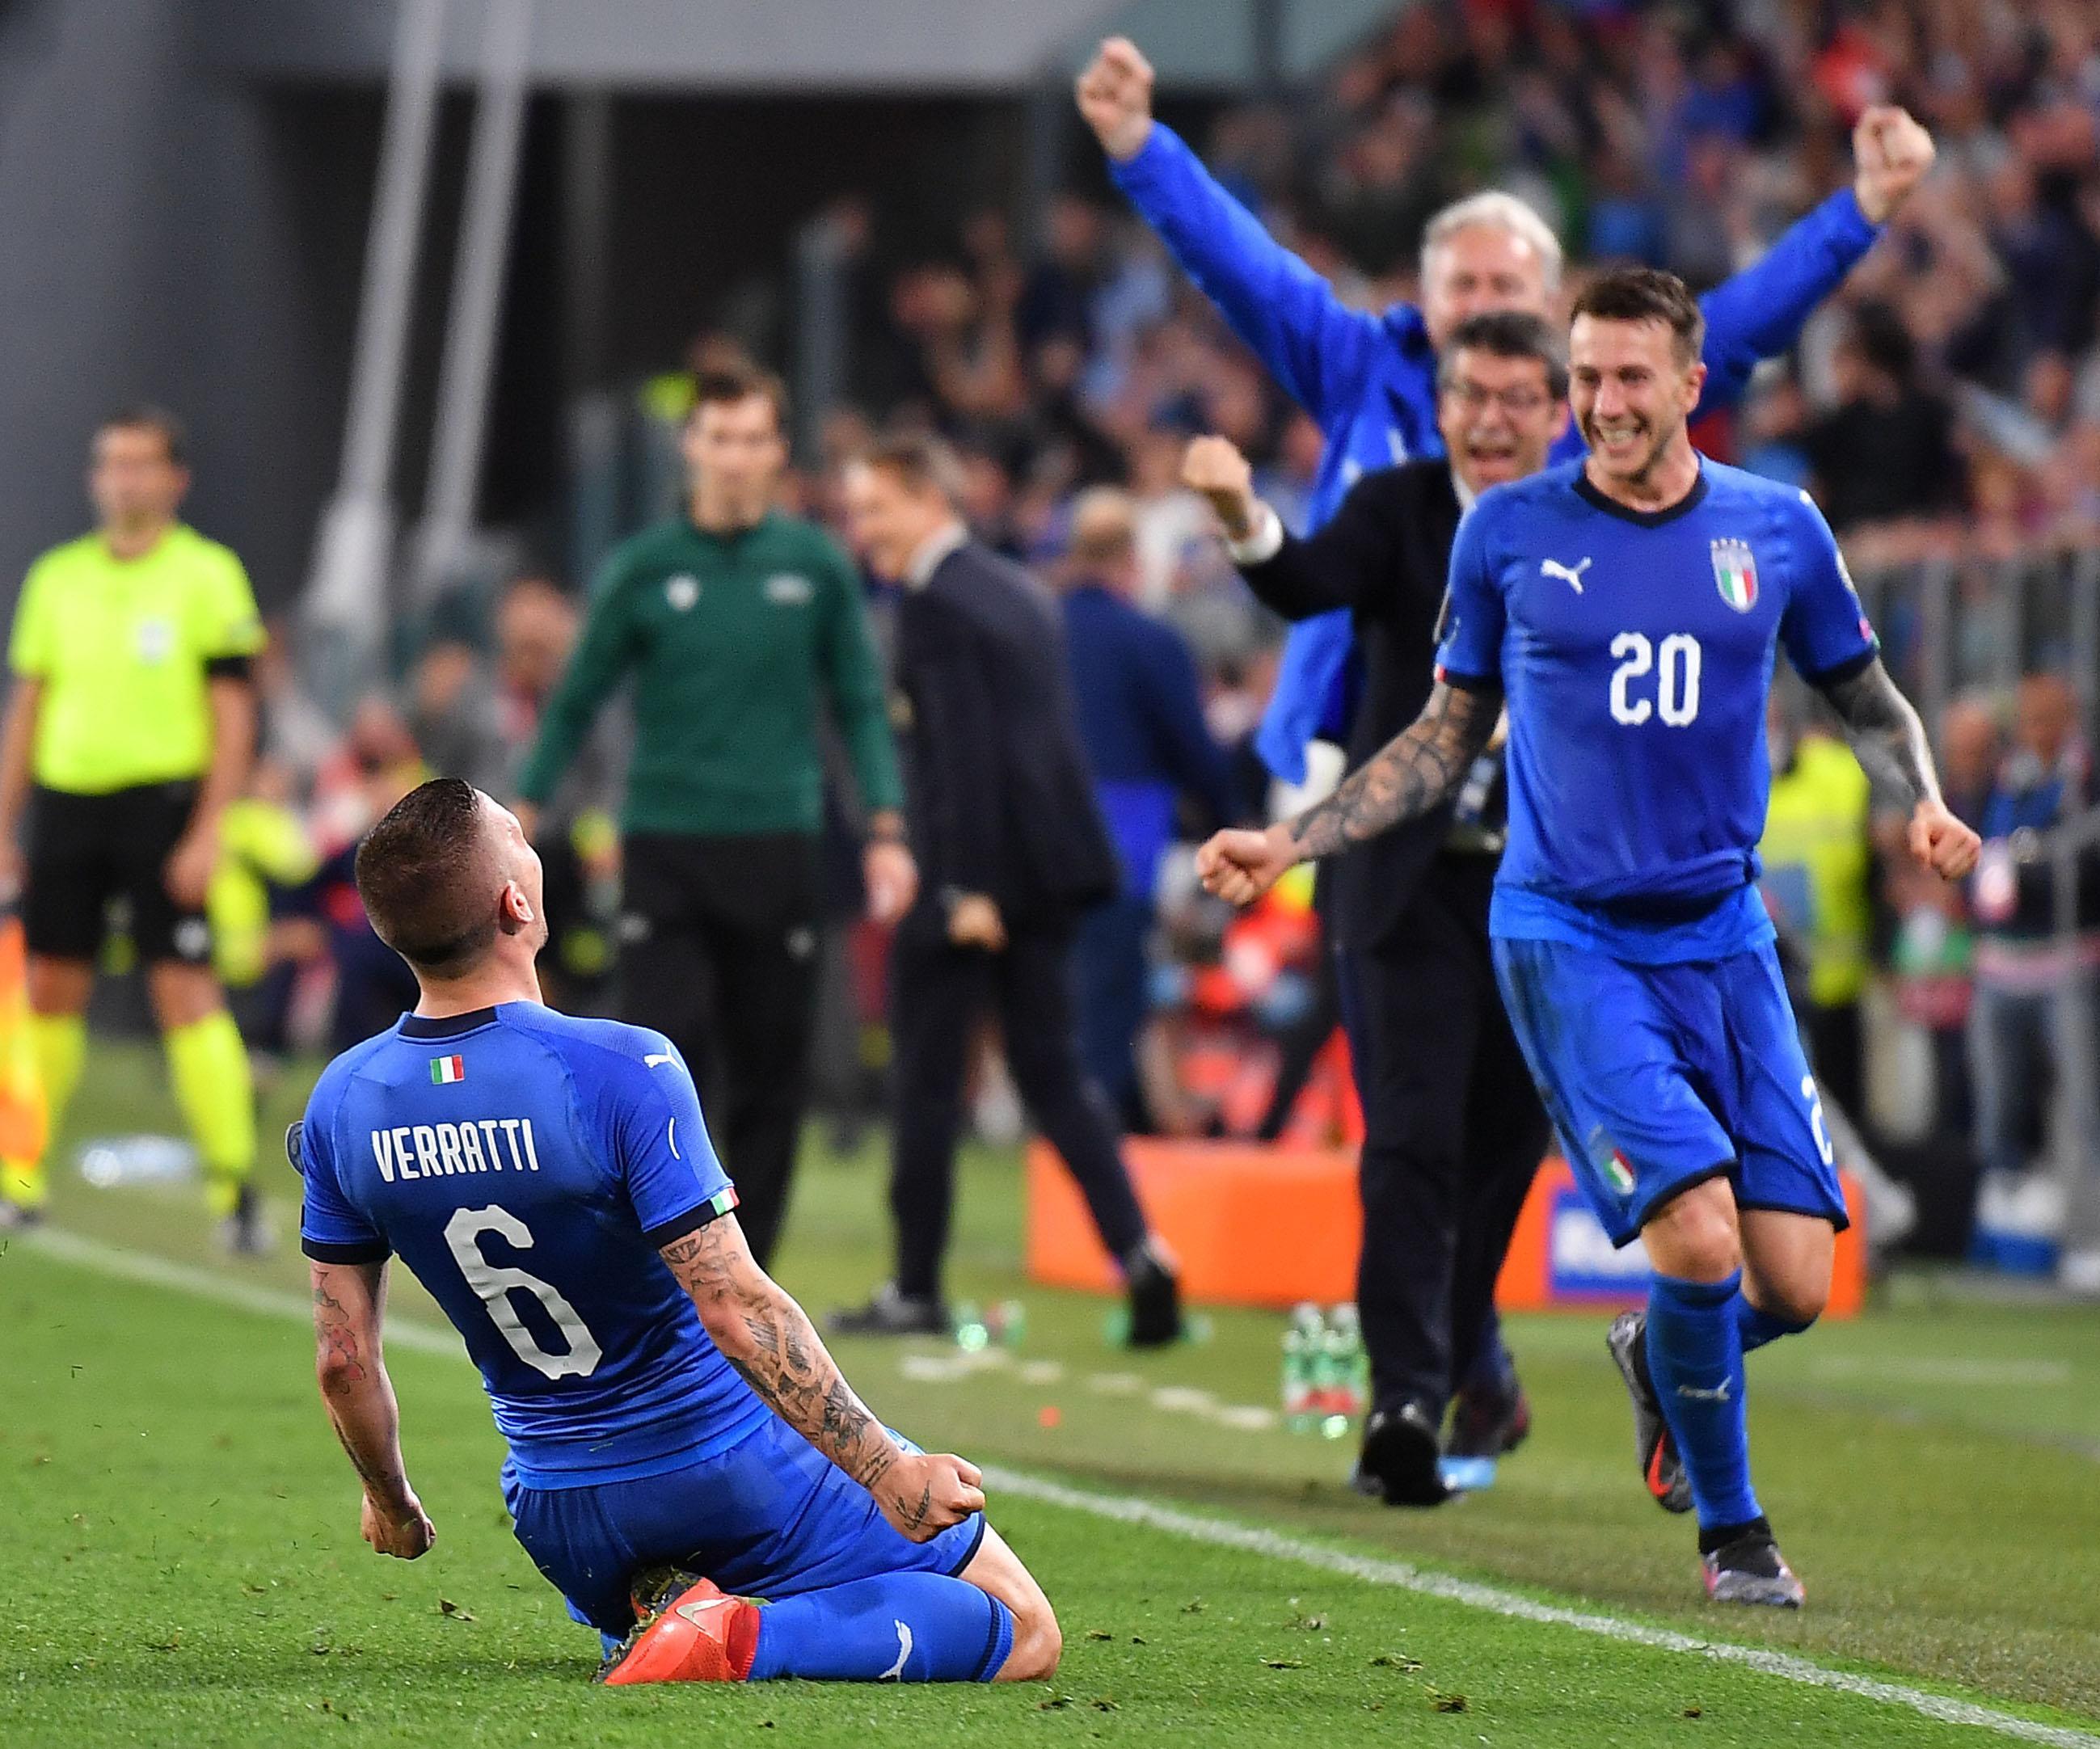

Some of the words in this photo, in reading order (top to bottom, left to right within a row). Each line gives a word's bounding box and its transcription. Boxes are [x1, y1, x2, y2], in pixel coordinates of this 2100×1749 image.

[1610, 632, 1702, 727] 20
[371, 1119, 539, 1182] VERRATTI
[444, 1204, 602, 1380] 6
